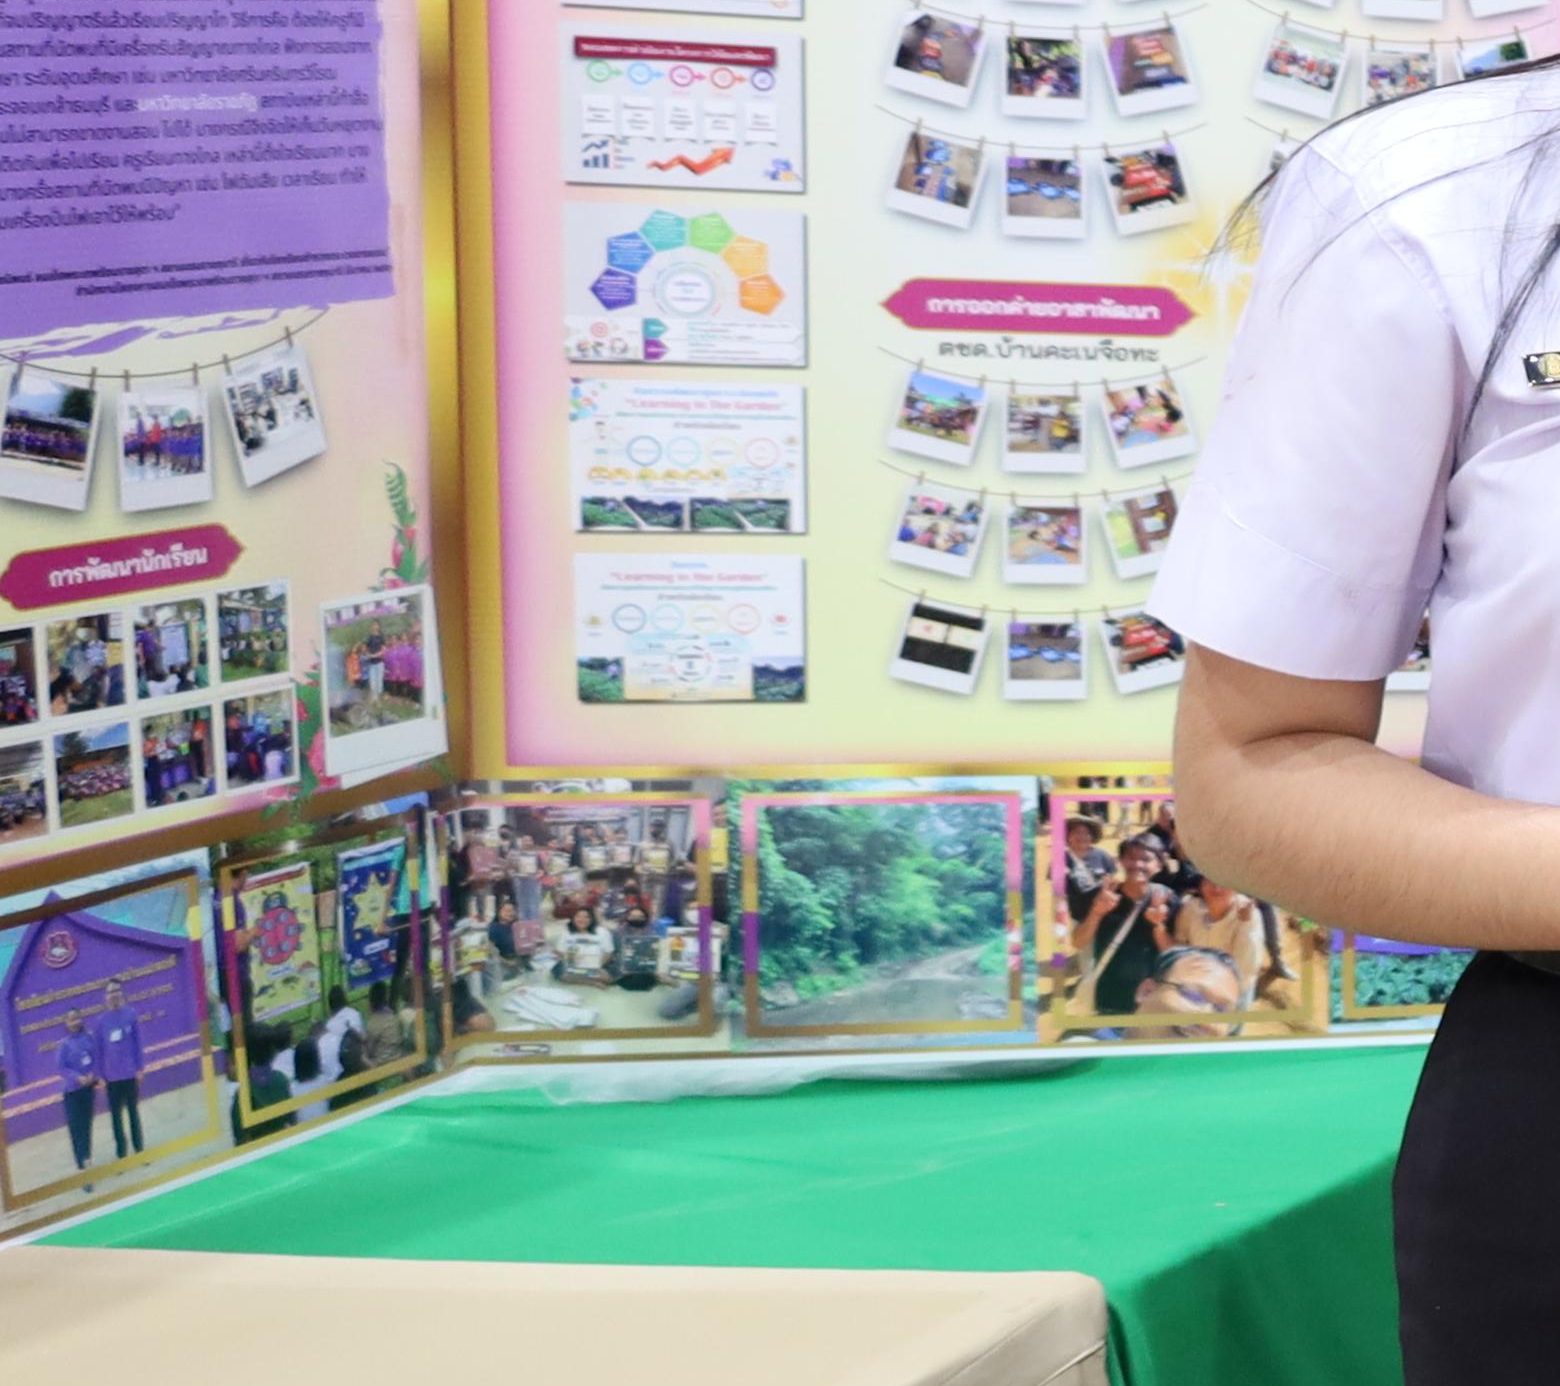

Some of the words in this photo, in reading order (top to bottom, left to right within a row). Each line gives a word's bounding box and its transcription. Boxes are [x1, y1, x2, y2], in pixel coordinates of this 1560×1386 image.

[49, 541, 209, 588] การพัฒนานักเรียน
